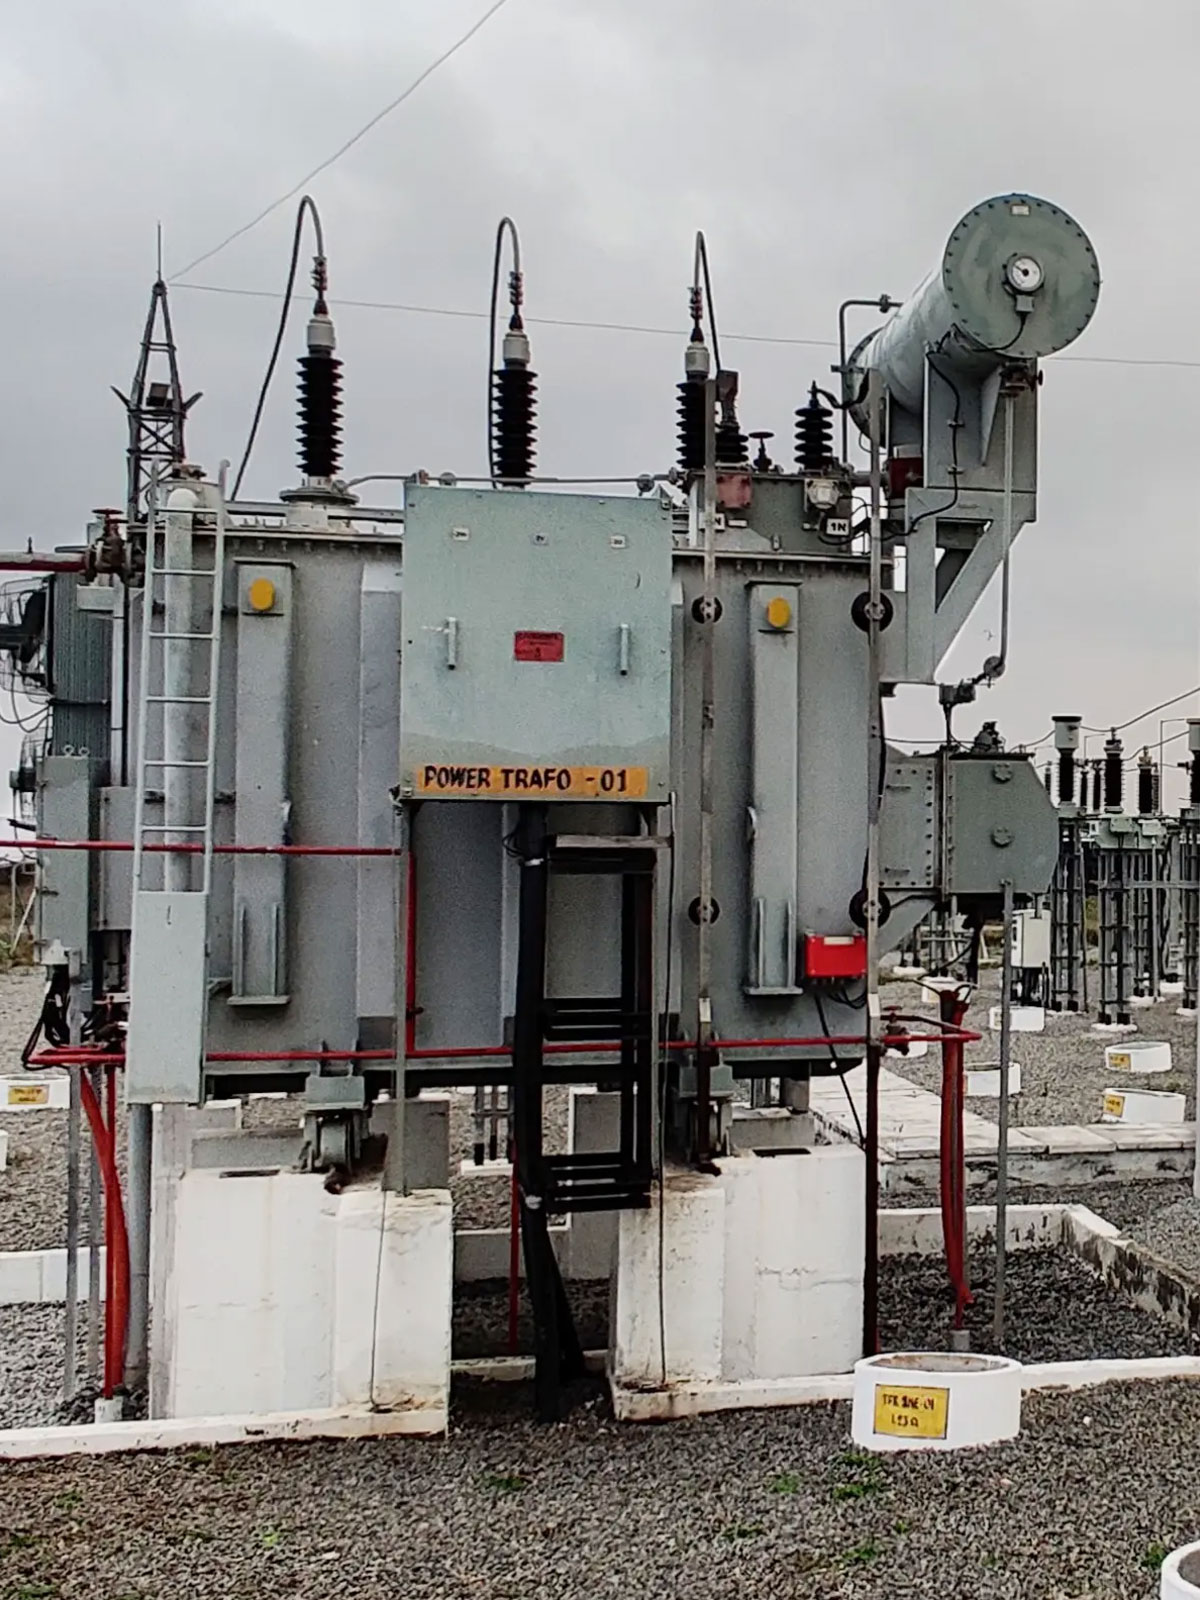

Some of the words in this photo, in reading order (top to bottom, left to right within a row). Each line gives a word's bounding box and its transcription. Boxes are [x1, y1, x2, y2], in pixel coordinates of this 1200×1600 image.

[830, 522, 847, 533] 1N
[424, 765, 491, 789] POWER
[501, 768, 571, 791] TRAFO
